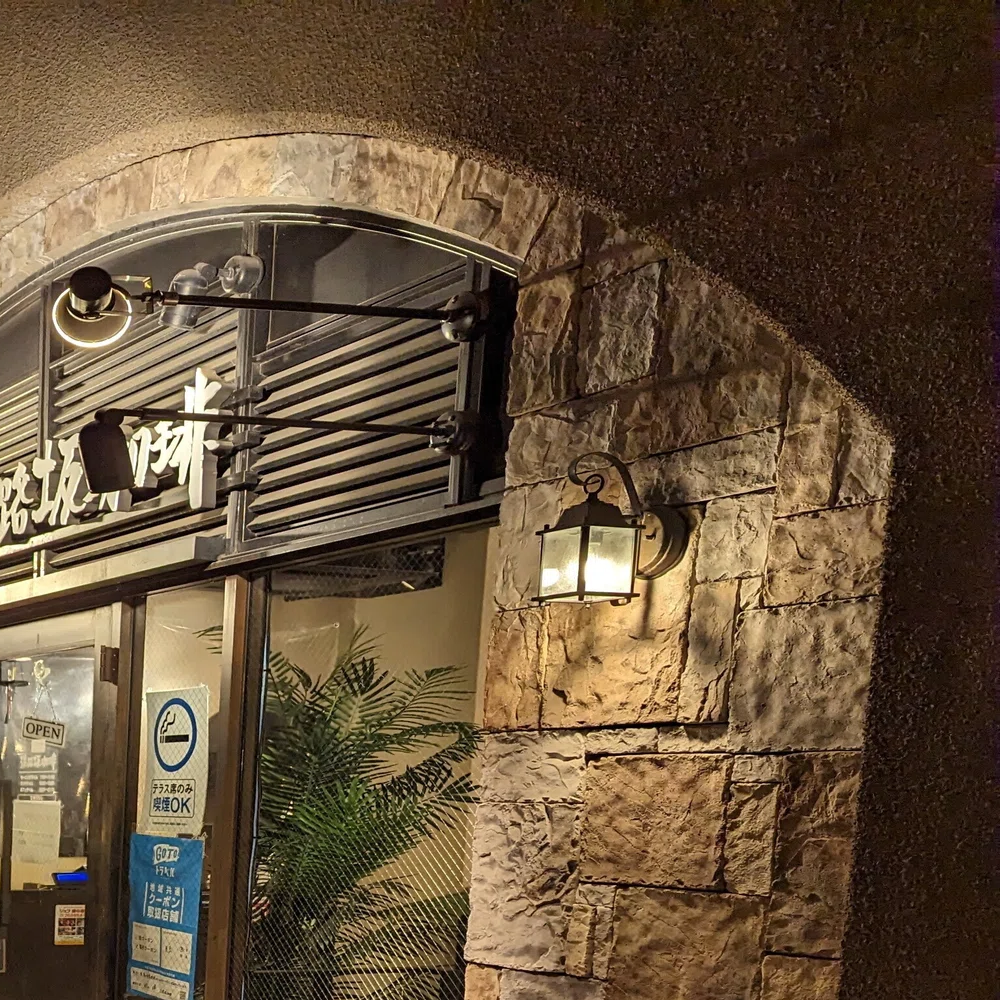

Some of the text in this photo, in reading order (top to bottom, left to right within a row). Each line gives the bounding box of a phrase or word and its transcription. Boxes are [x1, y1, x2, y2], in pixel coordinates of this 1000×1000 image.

[25, 722, 61, 740] OPEN
[152, 783, 193, 794] テラス席のみ
[153, 797, 191, 813] 喫煙OK
[149, 893, 180, 908] クーポン
